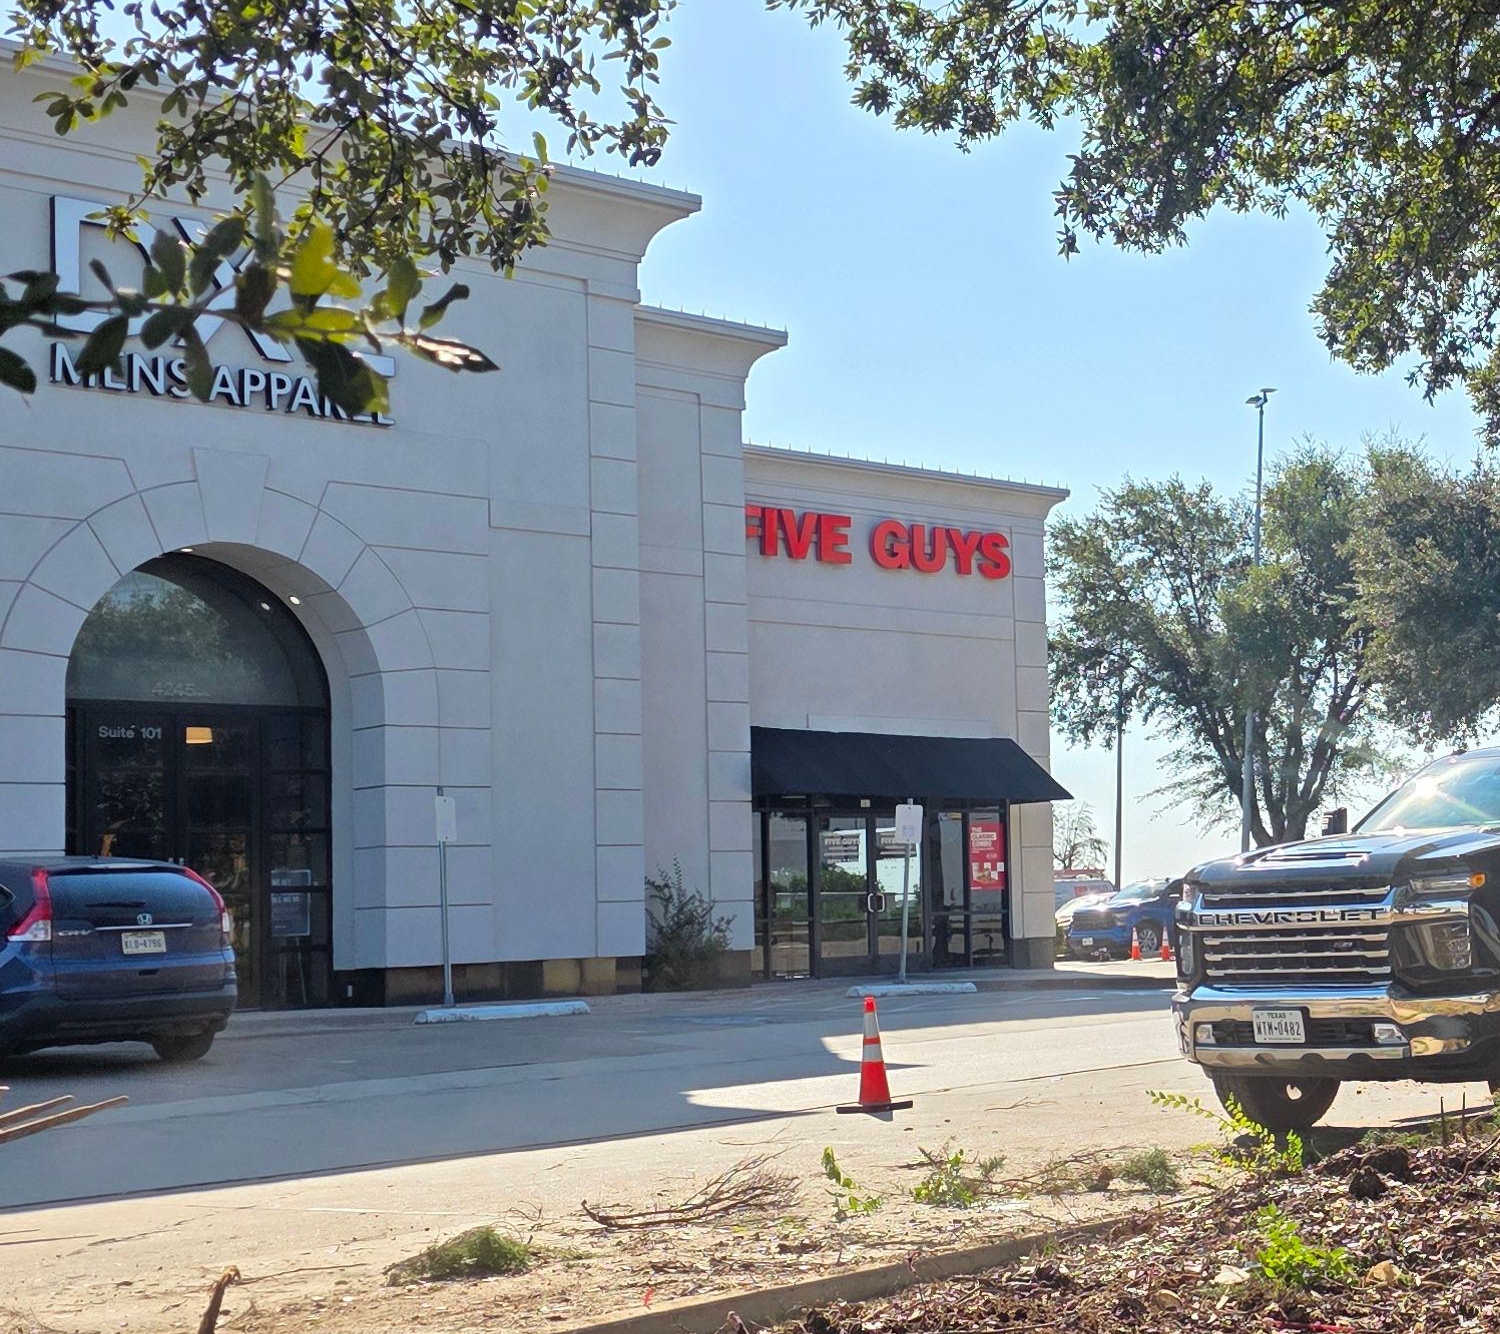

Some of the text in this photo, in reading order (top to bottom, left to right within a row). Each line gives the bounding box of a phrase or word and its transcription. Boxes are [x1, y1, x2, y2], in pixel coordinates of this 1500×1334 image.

[209, 365, 396, 427] APPA
[870, 519, 1011, 580] GUYS
[98, 725, 162, 739] Suite 101
[1199, 907, 1384, 925] CHEVROLET
